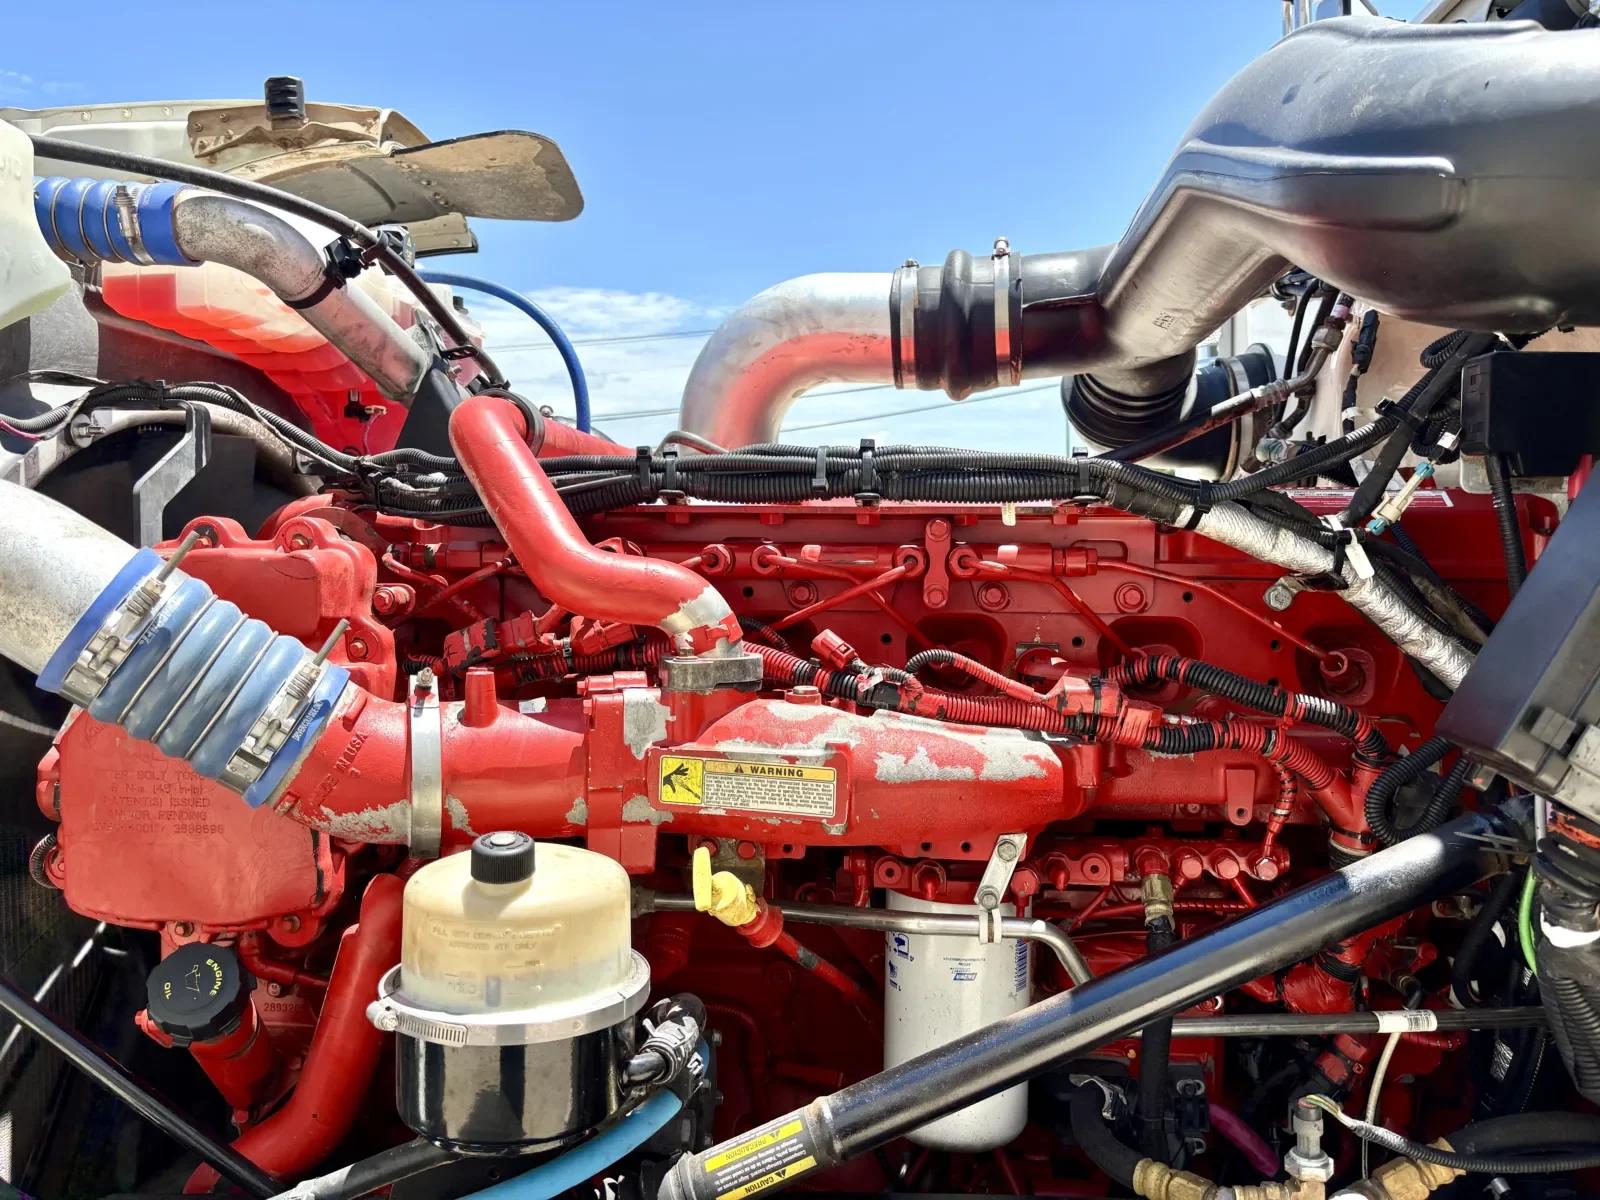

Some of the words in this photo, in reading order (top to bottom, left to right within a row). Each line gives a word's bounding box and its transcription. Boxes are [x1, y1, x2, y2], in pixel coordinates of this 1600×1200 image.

[344, 729, 368, 757] USA
[750, 766, 804, 778] WARNING
[170, 796, 211, 808] ISSUED
[158, 810, 208, 820] PENDING
[206, 958, 222, 998] ENGINE
[163, 982, 172, 1000] OIL
[744, 1176, 774, 1194] CAUTION
